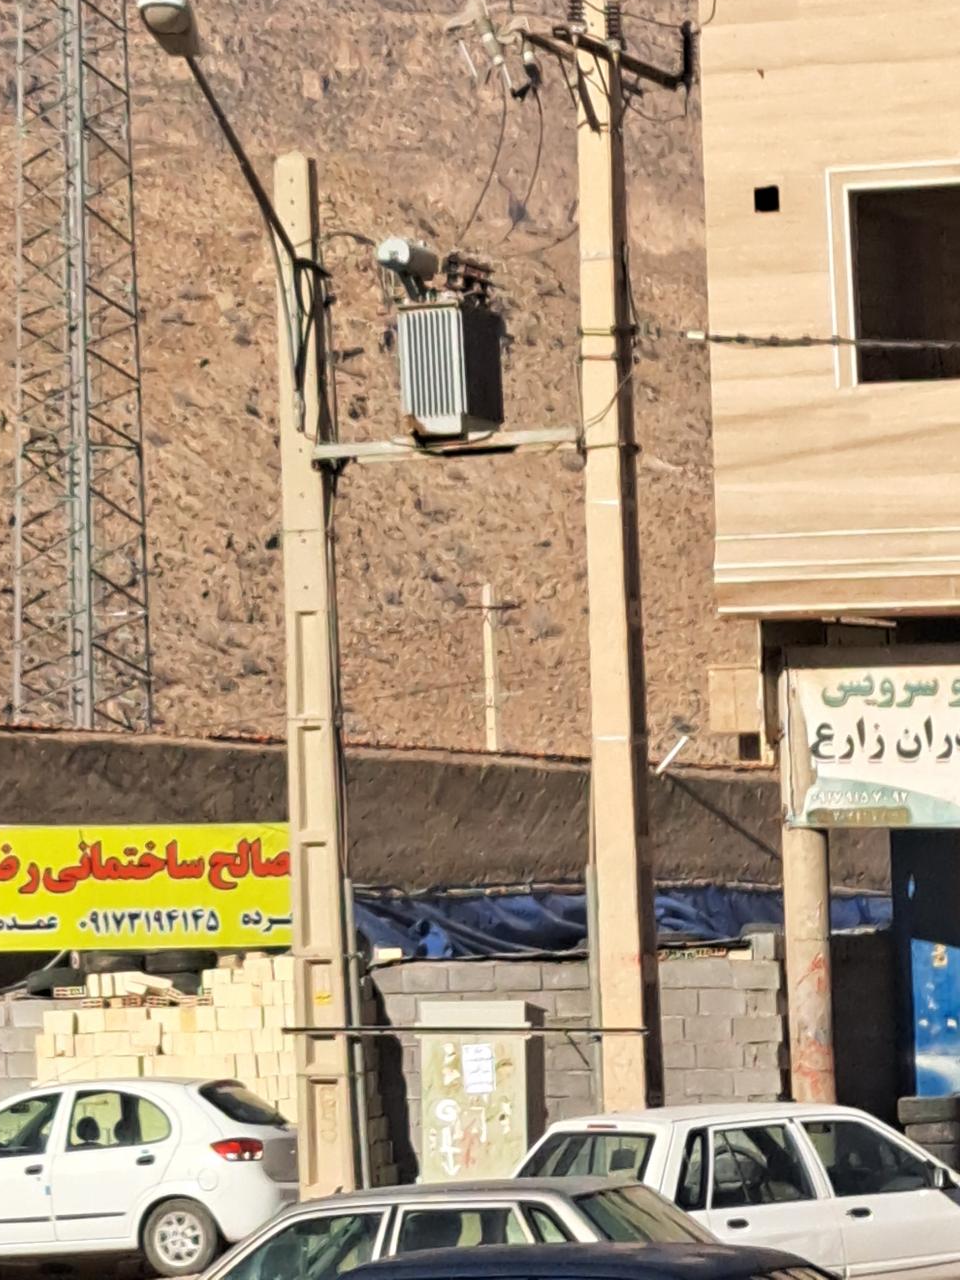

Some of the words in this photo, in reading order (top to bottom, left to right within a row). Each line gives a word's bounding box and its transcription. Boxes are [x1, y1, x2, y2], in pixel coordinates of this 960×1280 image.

[811, 716, 886, 761] زارع
[42, 837, 204, 893] ساختمانی
[208, 837, 291, 891] صالح
